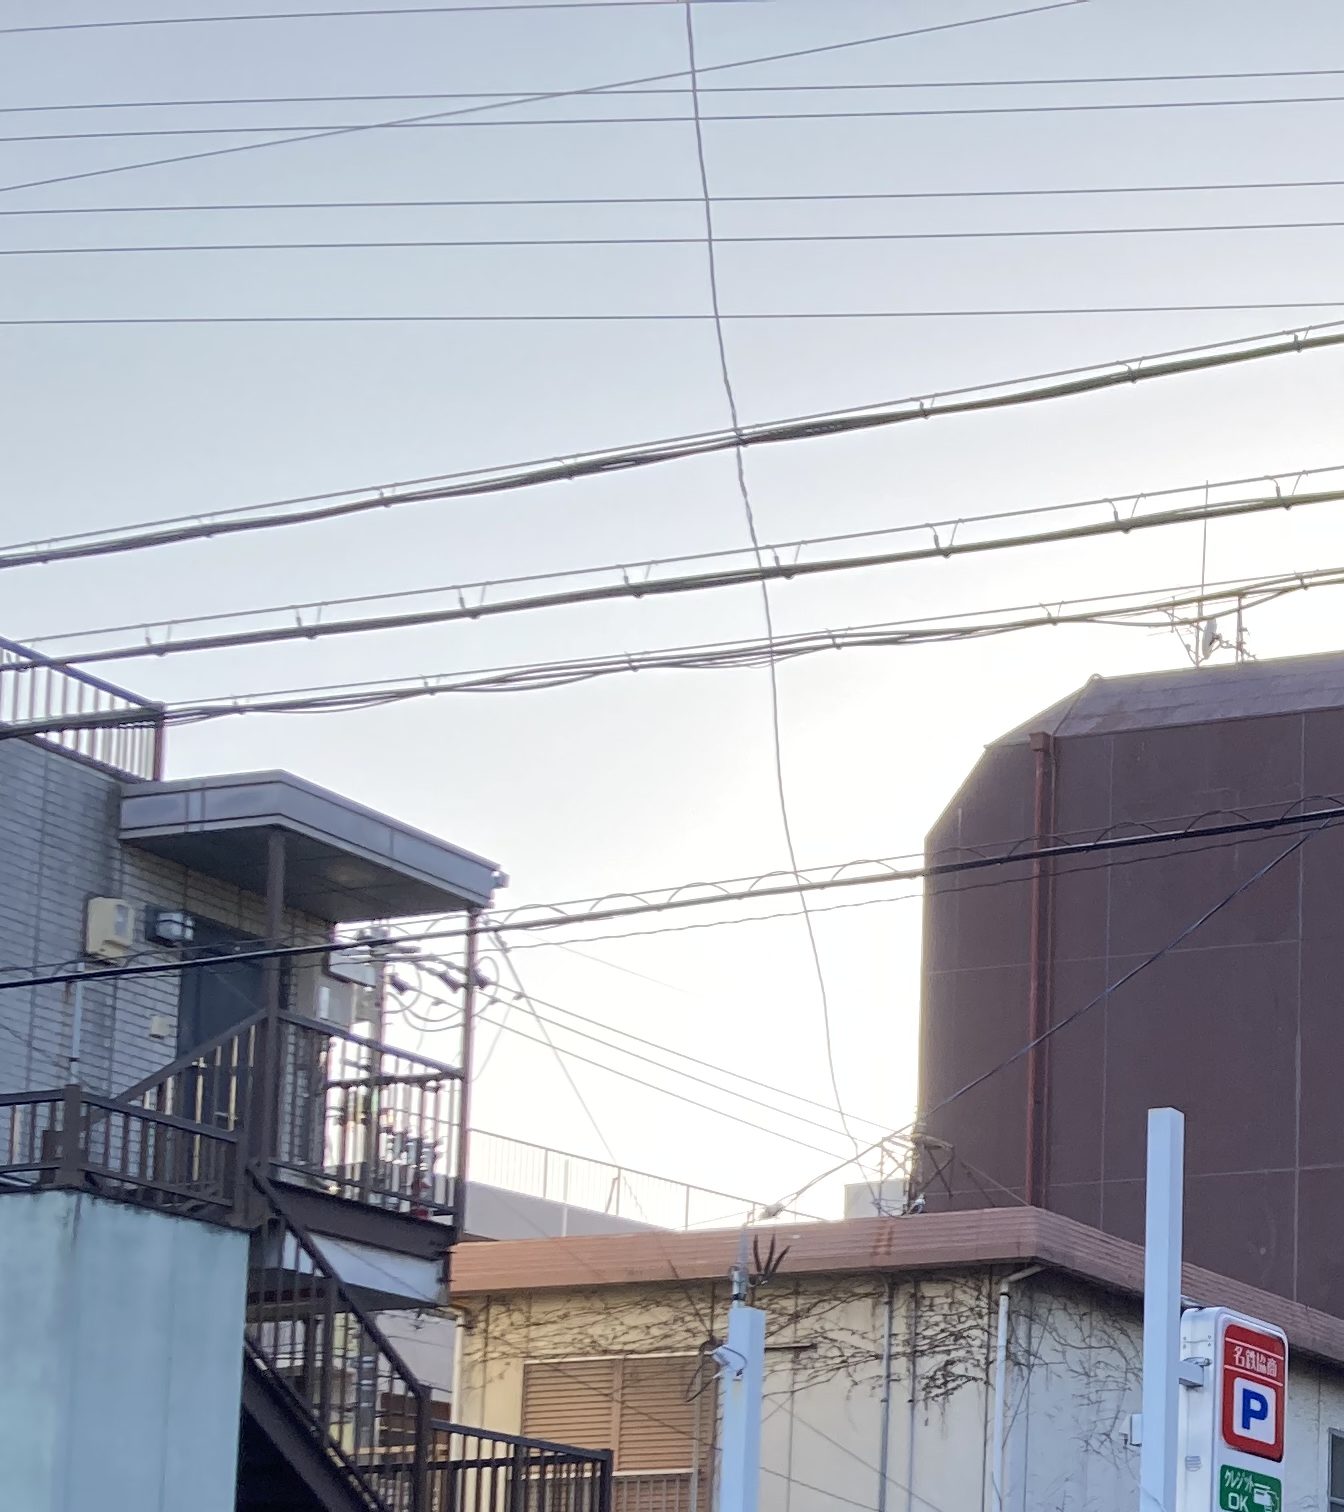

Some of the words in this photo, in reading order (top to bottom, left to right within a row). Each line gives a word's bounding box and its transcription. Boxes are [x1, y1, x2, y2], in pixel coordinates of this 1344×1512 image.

[1233, 1345, 1277, 1378] 名鉄協商
[1242, 1387, 1268, 1430] P
[1228, 1492, 1249, 1512] OK
